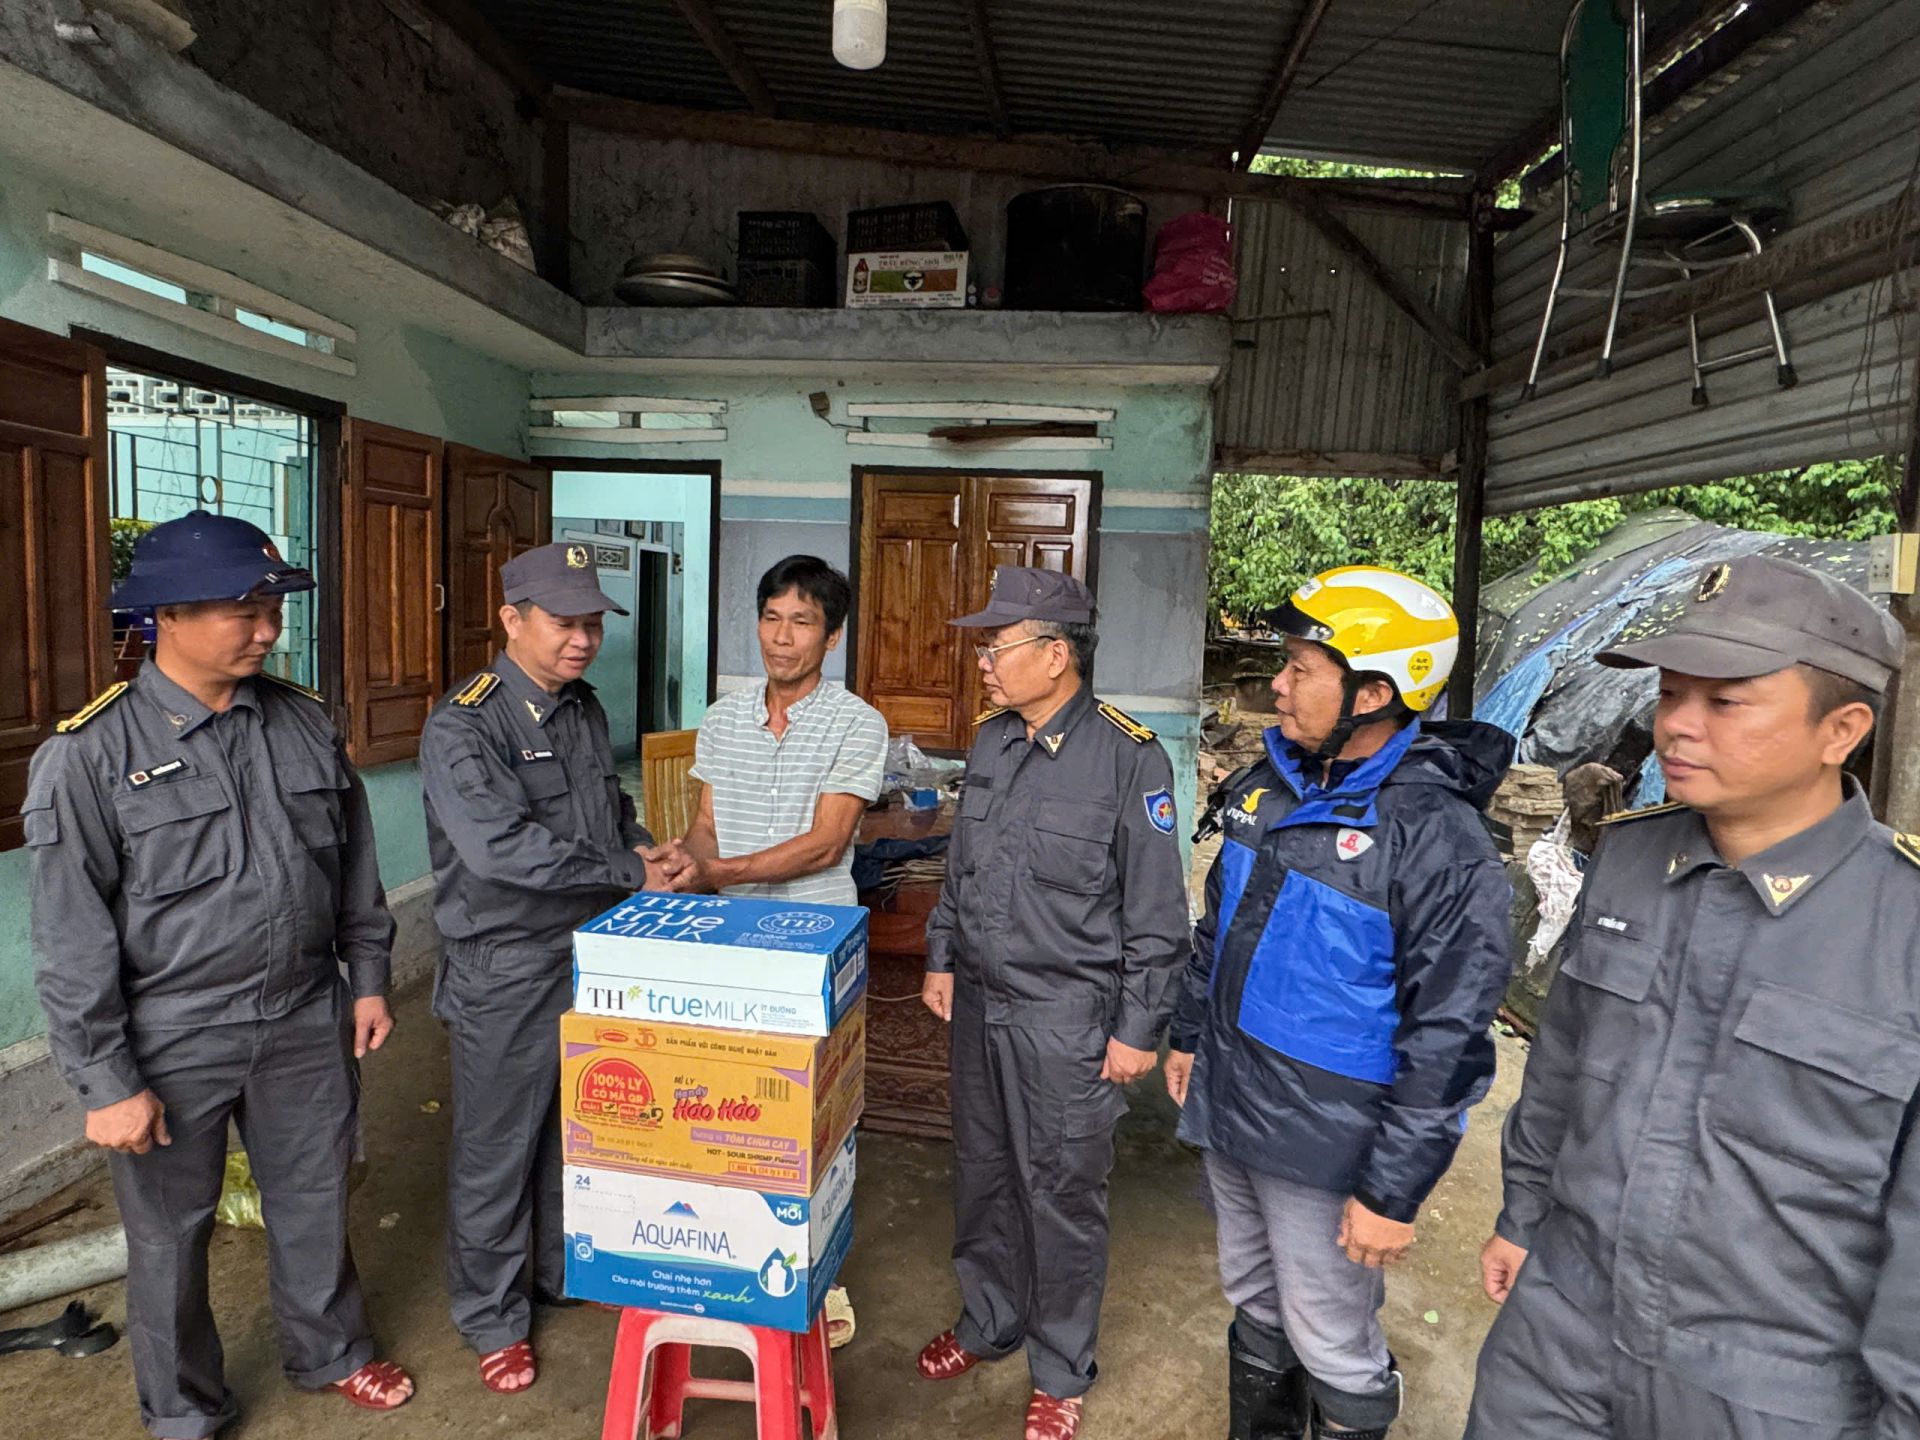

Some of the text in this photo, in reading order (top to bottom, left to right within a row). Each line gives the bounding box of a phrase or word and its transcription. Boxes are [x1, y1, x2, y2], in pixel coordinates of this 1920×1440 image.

[640, 896, 699, 911] TH
[612, 905, 724, 929] true
[780, 918, 817, 928] TH
[591, 919, 713, 940] MILK
[587, 987, 625, 1011] TH
[592, 1073, 643, 1091] 100% LY
[592, 1086, 644, 1104] CÓ MÃ QR
[674, 1085, 708, 1099] Handy
[673, 1094, 715, 1122] Hảo
[717, 1094, 761, 1122] Hảo
[725, 1133, 745, 1144] TÔM
[746, 1137, 770, 1148] CHUA
[771, 1140, 790, 1151] CAY
[707, 1148, 722, 1156] HOT
[727, 1150, 746, 1159] SOUR
[576, 1174, 591, 1185] 24
[632, 1219, 732, 1259] AQUAFINA
[652, 1270, 712, 1287] Chai nhẹ hơn
[612, 1274, 755, 1303] Cho môi trường thêm xanh
